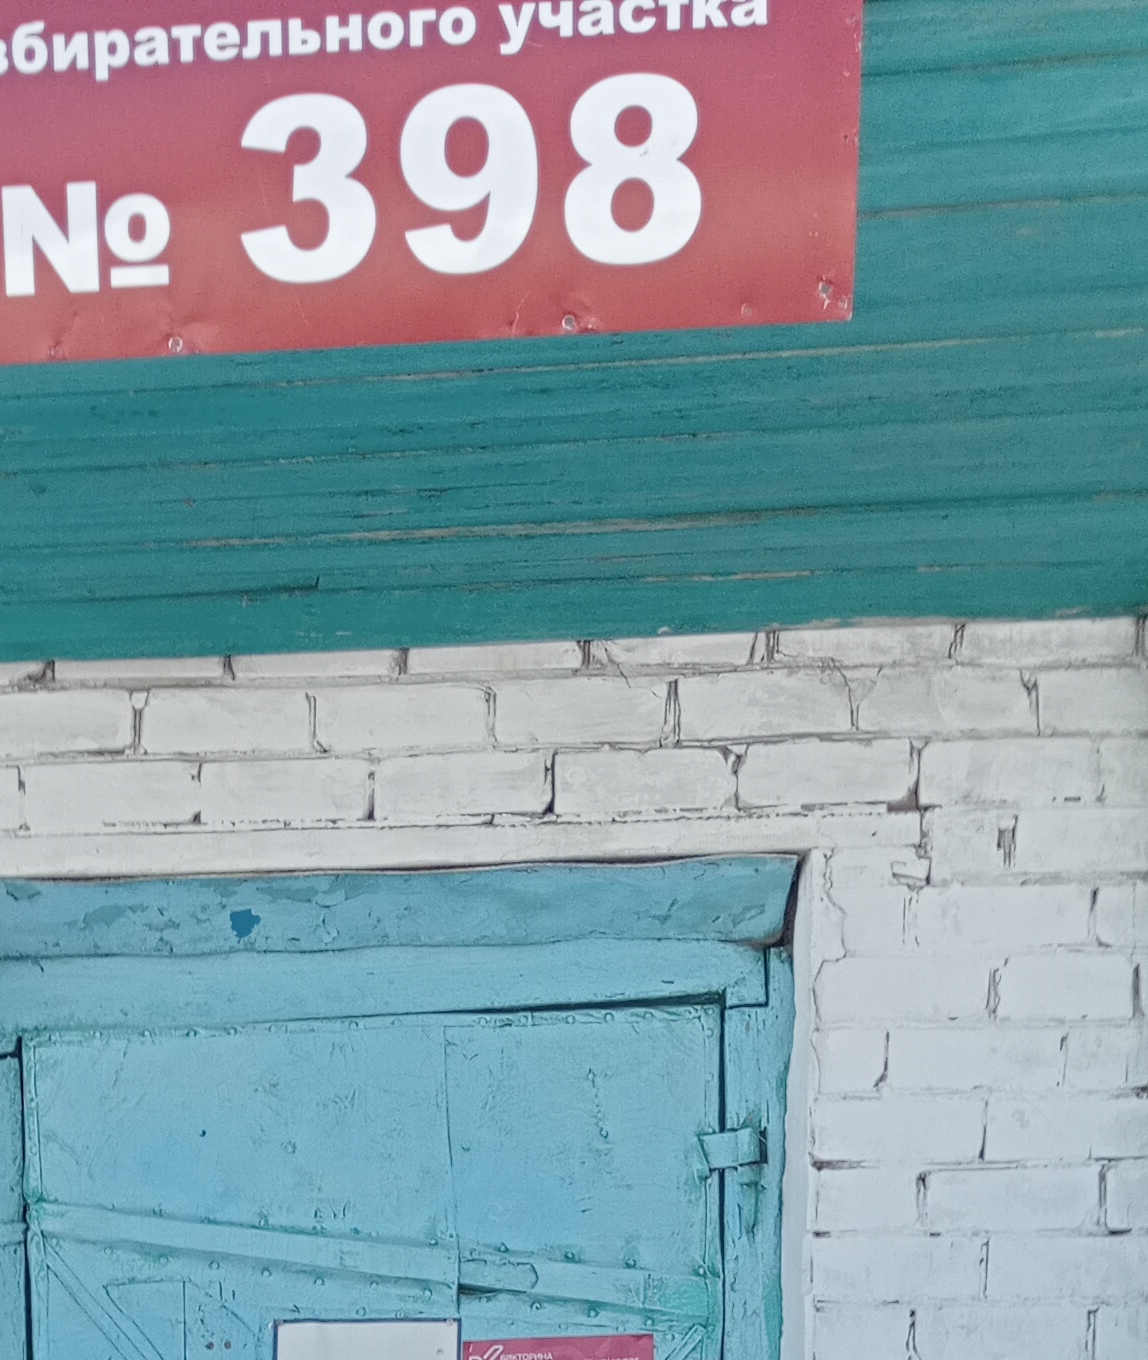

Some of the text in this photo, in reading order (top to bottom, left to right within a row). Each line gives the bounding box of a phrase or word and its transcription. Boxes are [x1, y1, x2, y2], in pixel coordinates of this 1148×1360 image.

[499, 0, 769, 56] участка
[0, 72, 702, 297] № 398
